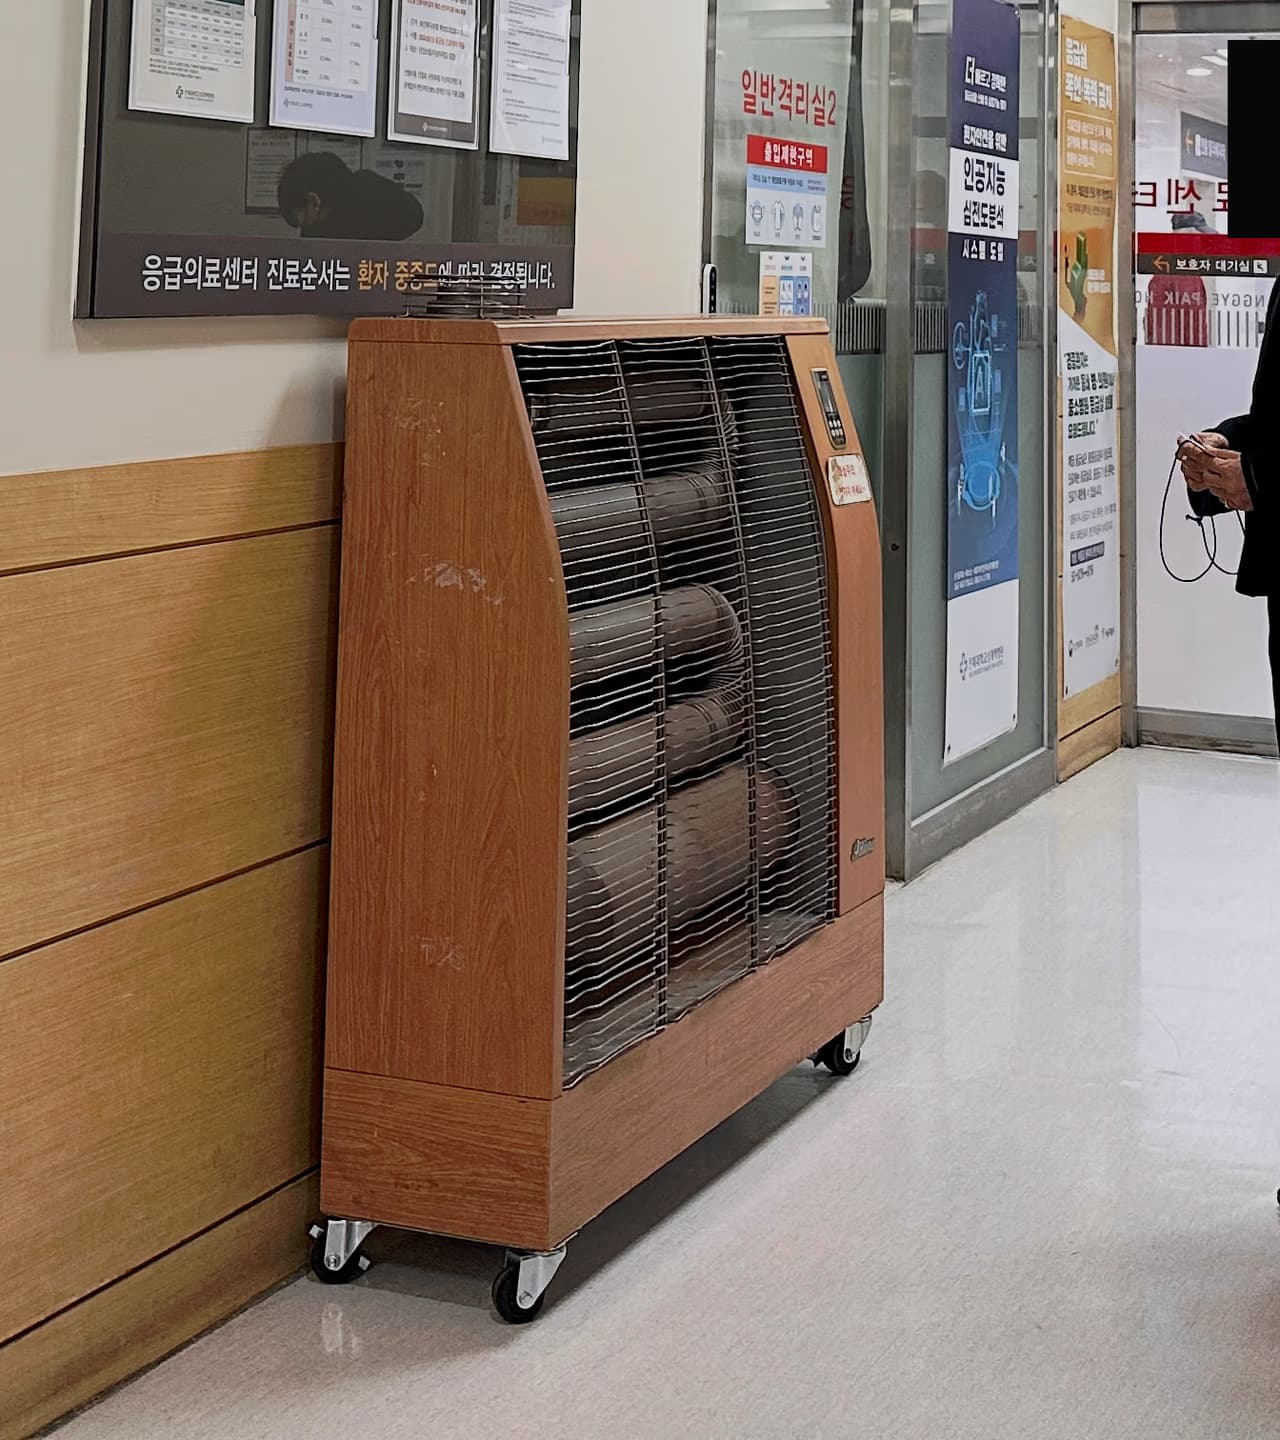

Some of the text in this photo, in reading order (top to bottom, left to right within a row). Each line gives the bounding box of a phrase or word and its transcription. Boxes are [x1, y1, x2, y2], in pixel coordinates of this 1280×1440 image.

[965, 56, 975, 85] 더
[741, 69, 837, 127] 일반격리실2
[764, 141, 813, 167] 출입제한구역
[963, 156, 1005, 196] 인공지능
[142, 255, 258, 291] 응급의료센터
[267, 258, 350, 291] 진료순서는
[357, 259, 388, 291] 환자
[1175, 258, 1250, 273] 보호자 대기실
